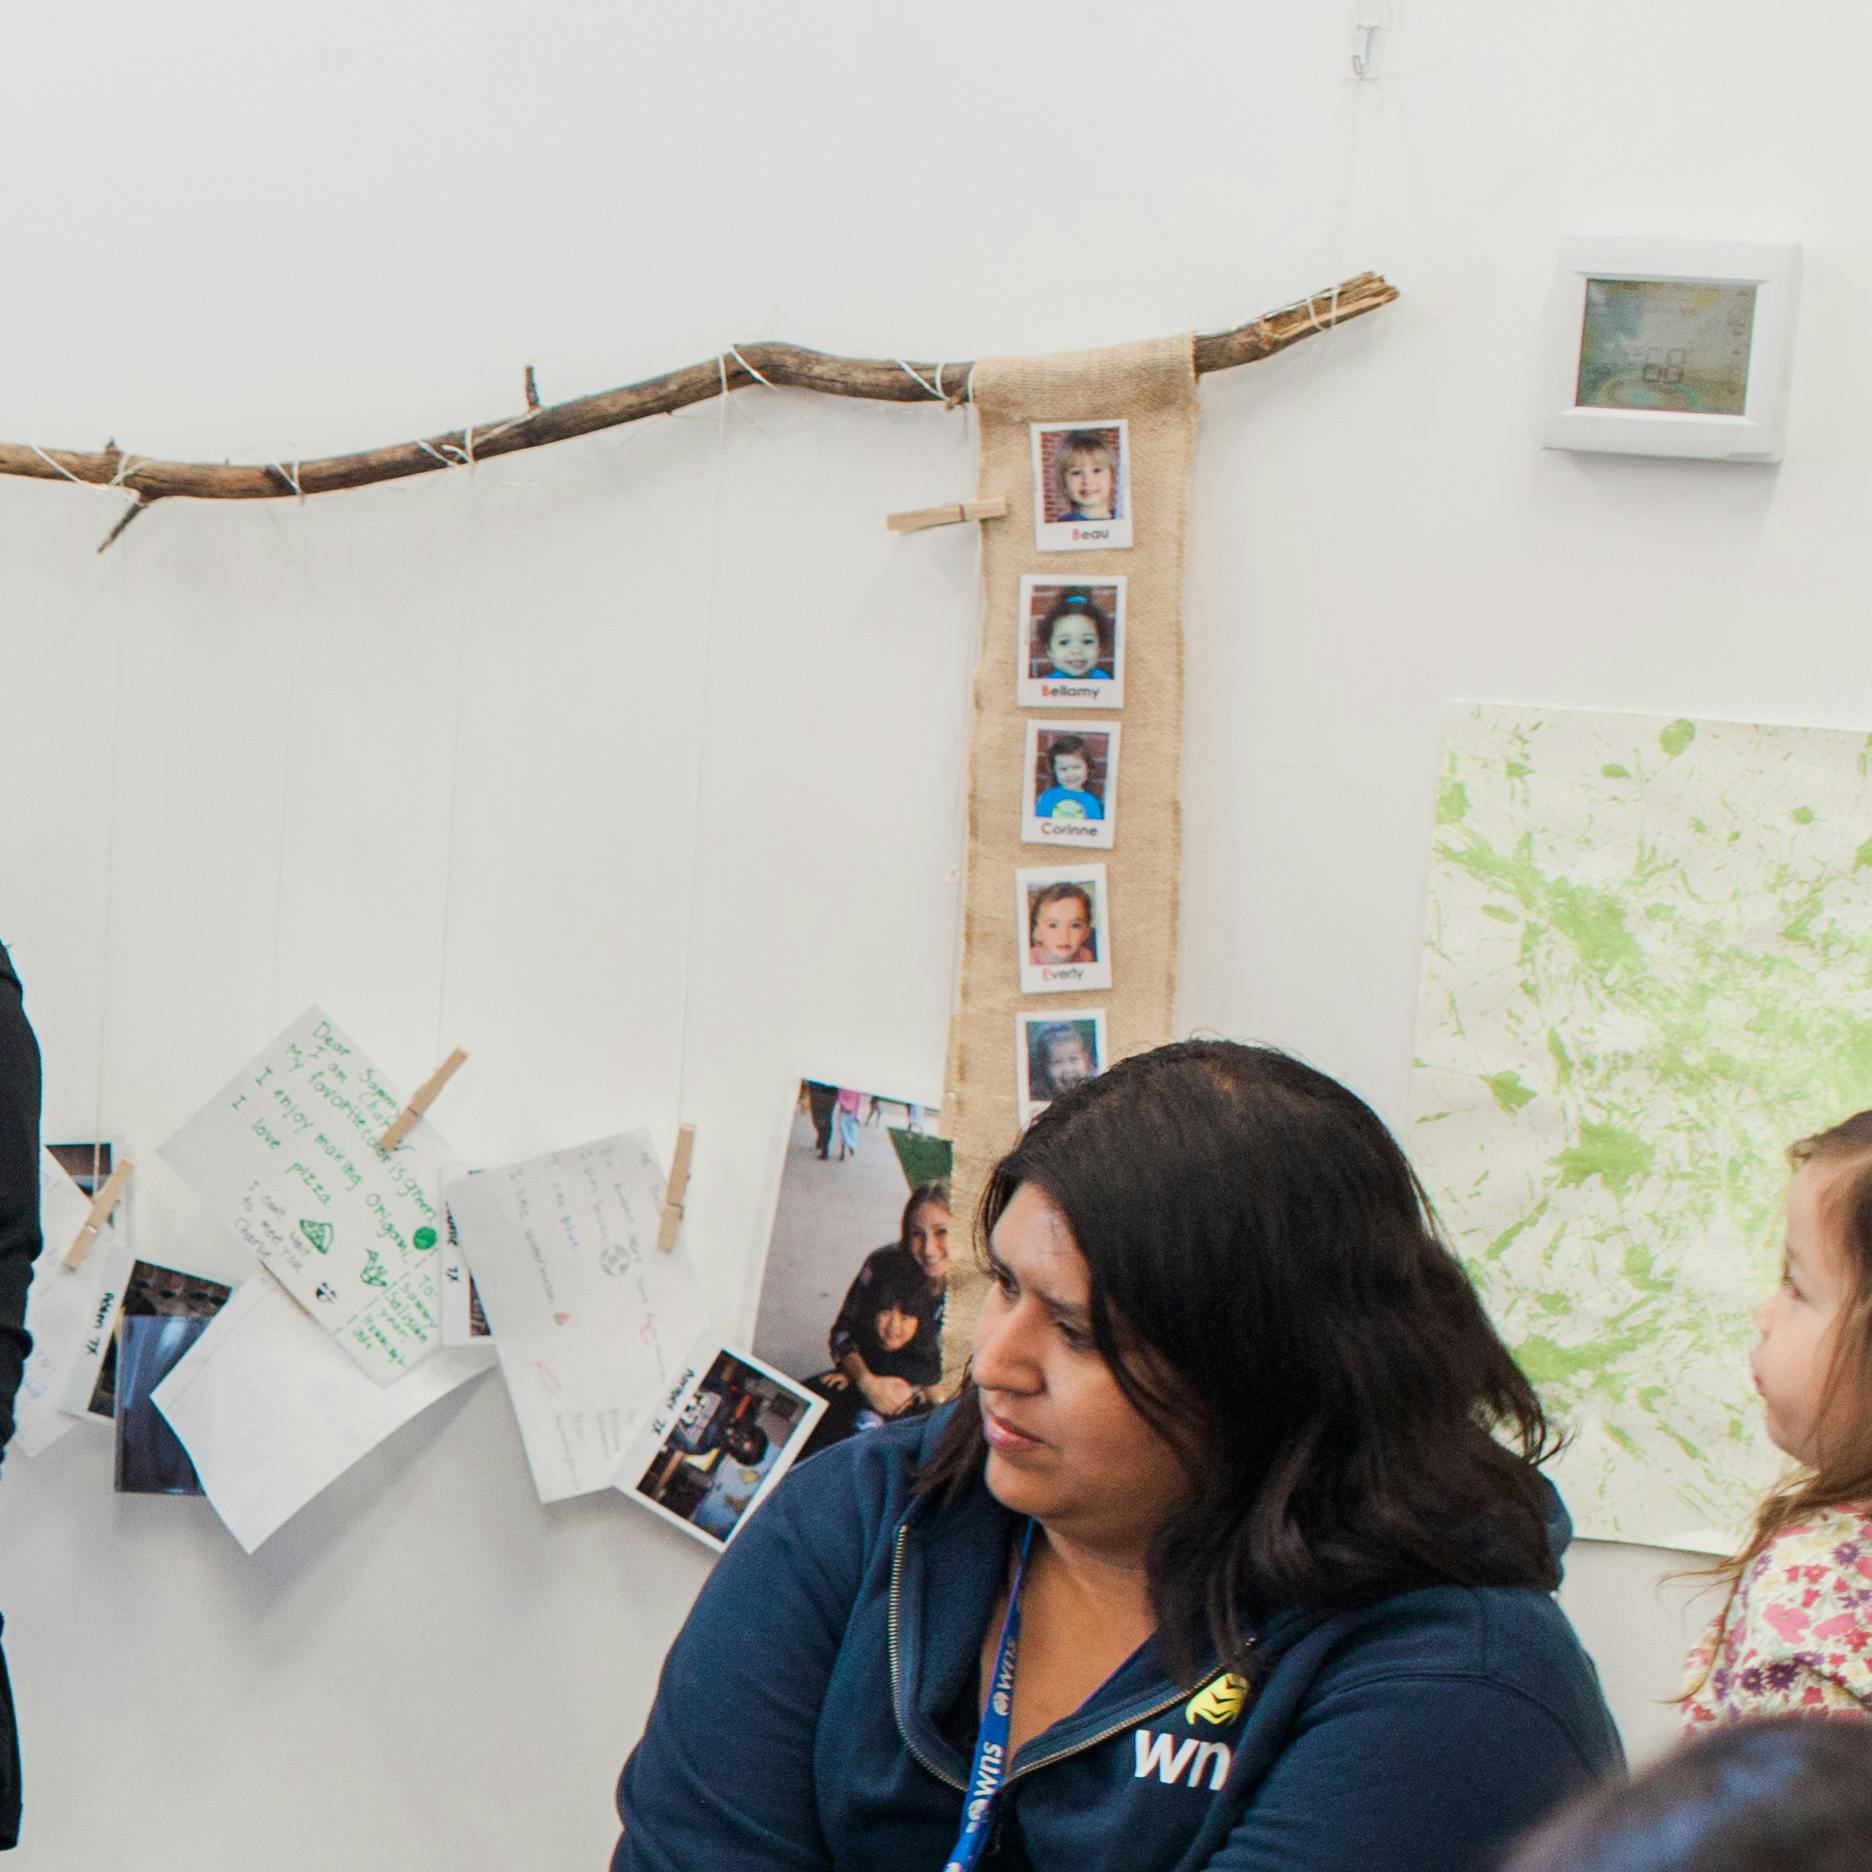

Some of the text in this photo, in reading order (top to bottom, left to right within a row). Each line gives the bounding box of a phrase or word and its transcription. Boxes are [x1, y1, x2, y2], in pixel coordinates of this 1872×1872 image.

[1071, 527, 1110, 541] Beau
[1041, 684, 1101, 700] Bellamy
[1041, 821, 1099, 838] Corinne
[1042, 966, 1085, 982] Everly
[312, 1019, 352, 1056] Dear
[287, 1042, 305, 1072] My
[309, 1070, 367, 1128] favorite
[327, 1062, 349, 1083] am
[254, 1066, 274, 1087] I
[273, 1088, 313, 1134] enjoy
[314, 1132, 363, 1192] making
[230, 1093, 332, 1205] I love pizza
[973, 1741, 1005, 1797] wns
[1134, 1728, 1231, 1792] wn
